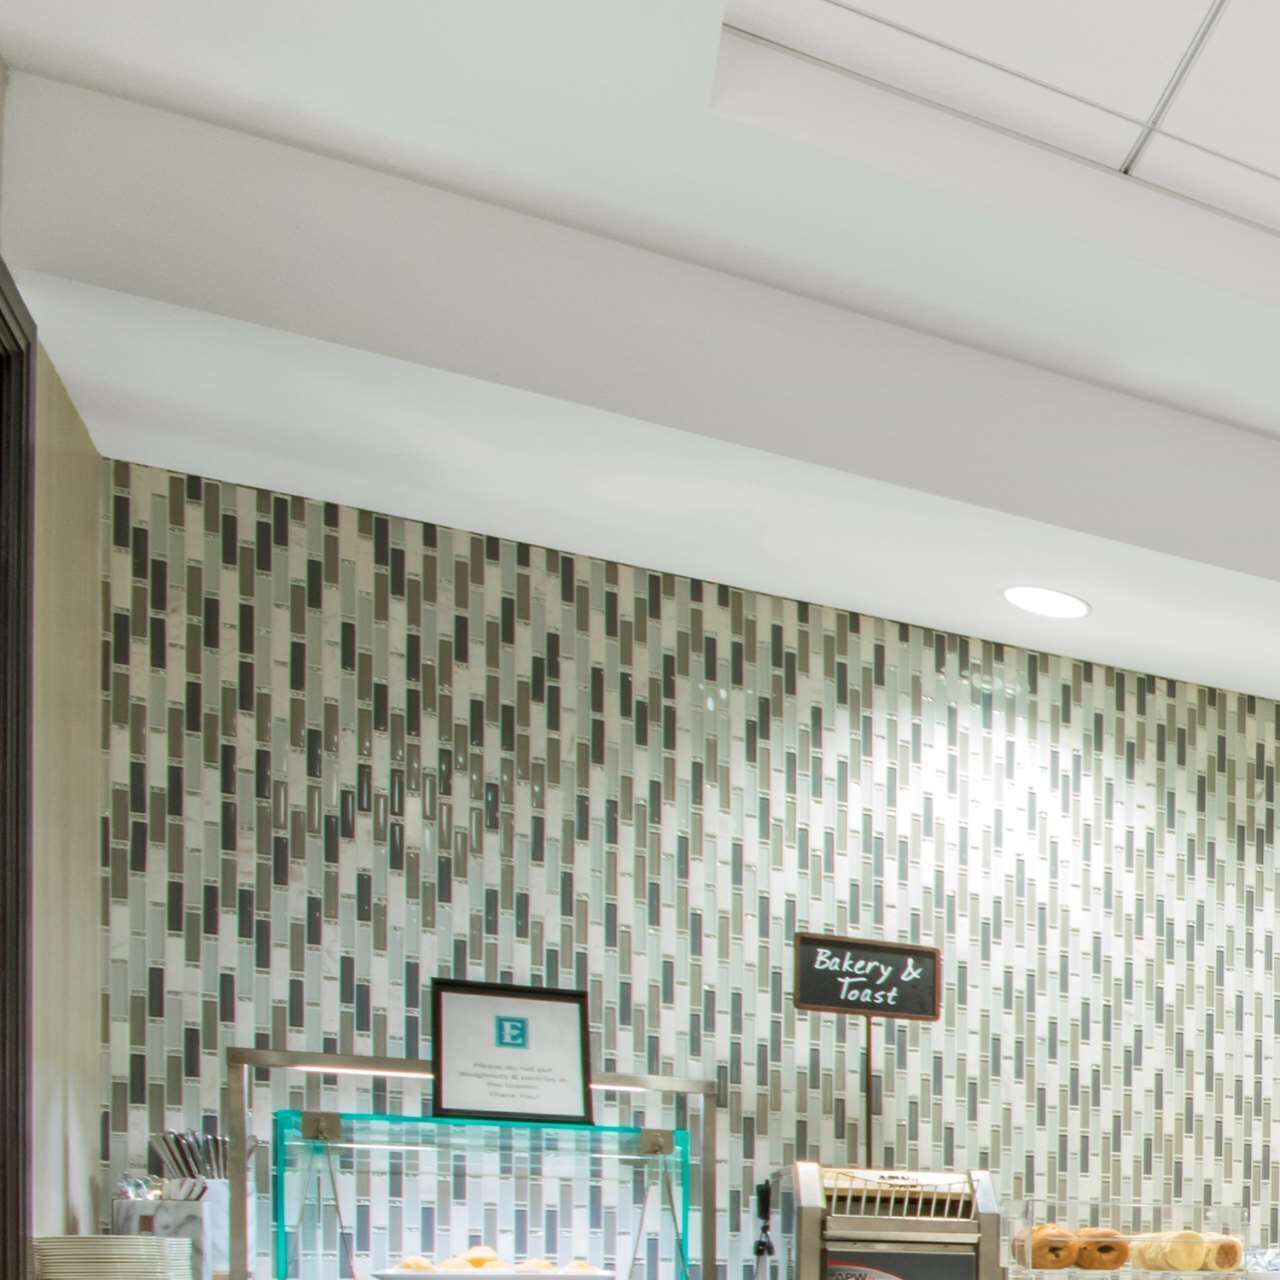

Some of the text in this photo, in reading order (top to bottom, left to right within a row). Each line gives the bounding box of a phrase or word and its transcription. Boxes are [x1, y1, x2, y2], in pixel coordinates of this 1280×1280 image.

[814, 948, 923, 984] Bakery &
[837, 976, 898, 1005] Toast
[501, 1020, 523, 1045] E
